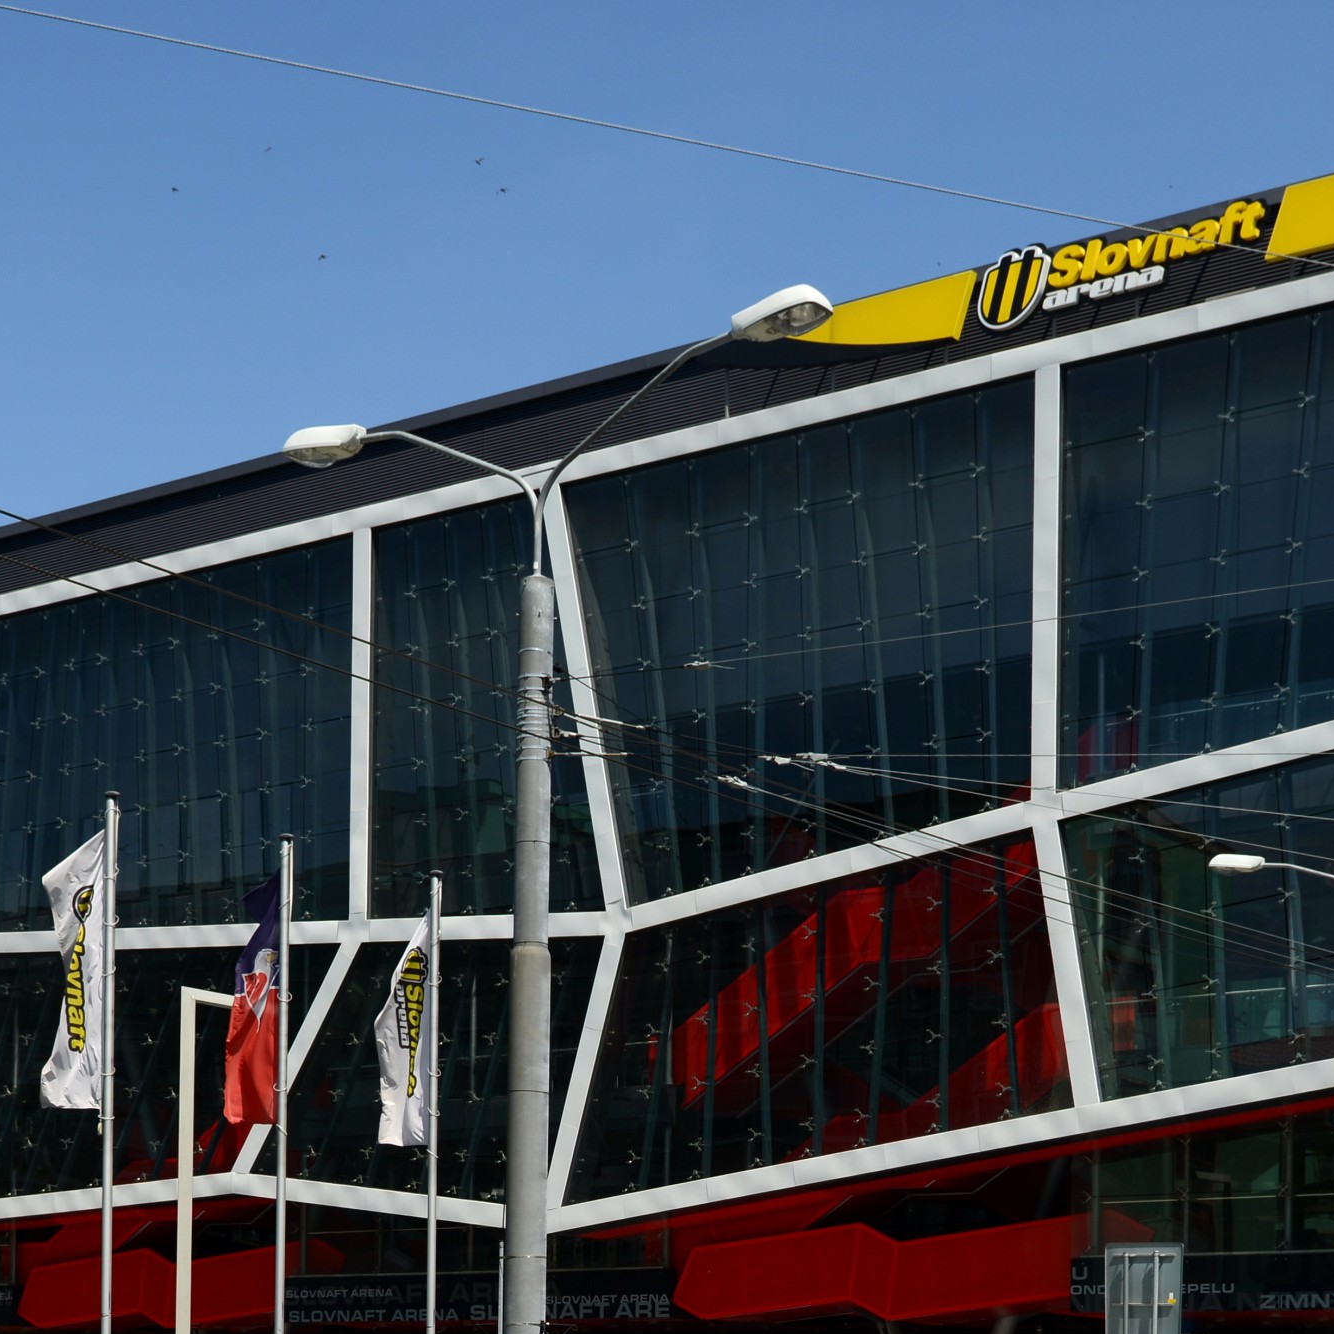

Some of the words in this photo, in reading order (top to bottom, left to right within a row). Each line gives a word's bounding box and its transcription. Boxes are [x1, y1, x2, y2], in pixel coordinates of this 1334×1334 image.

[1048, 200, 1265, 288] Slovnaft
[1042, 264, 1165, 313] arena
[286, 1290, 349, 1299] SLOVNAFT
[350, 1288, 394, 1298] ARENA
[620, 1293, 670, 1304] ARENA
[289, 1310, 387, 1323] SLOVNAFT
